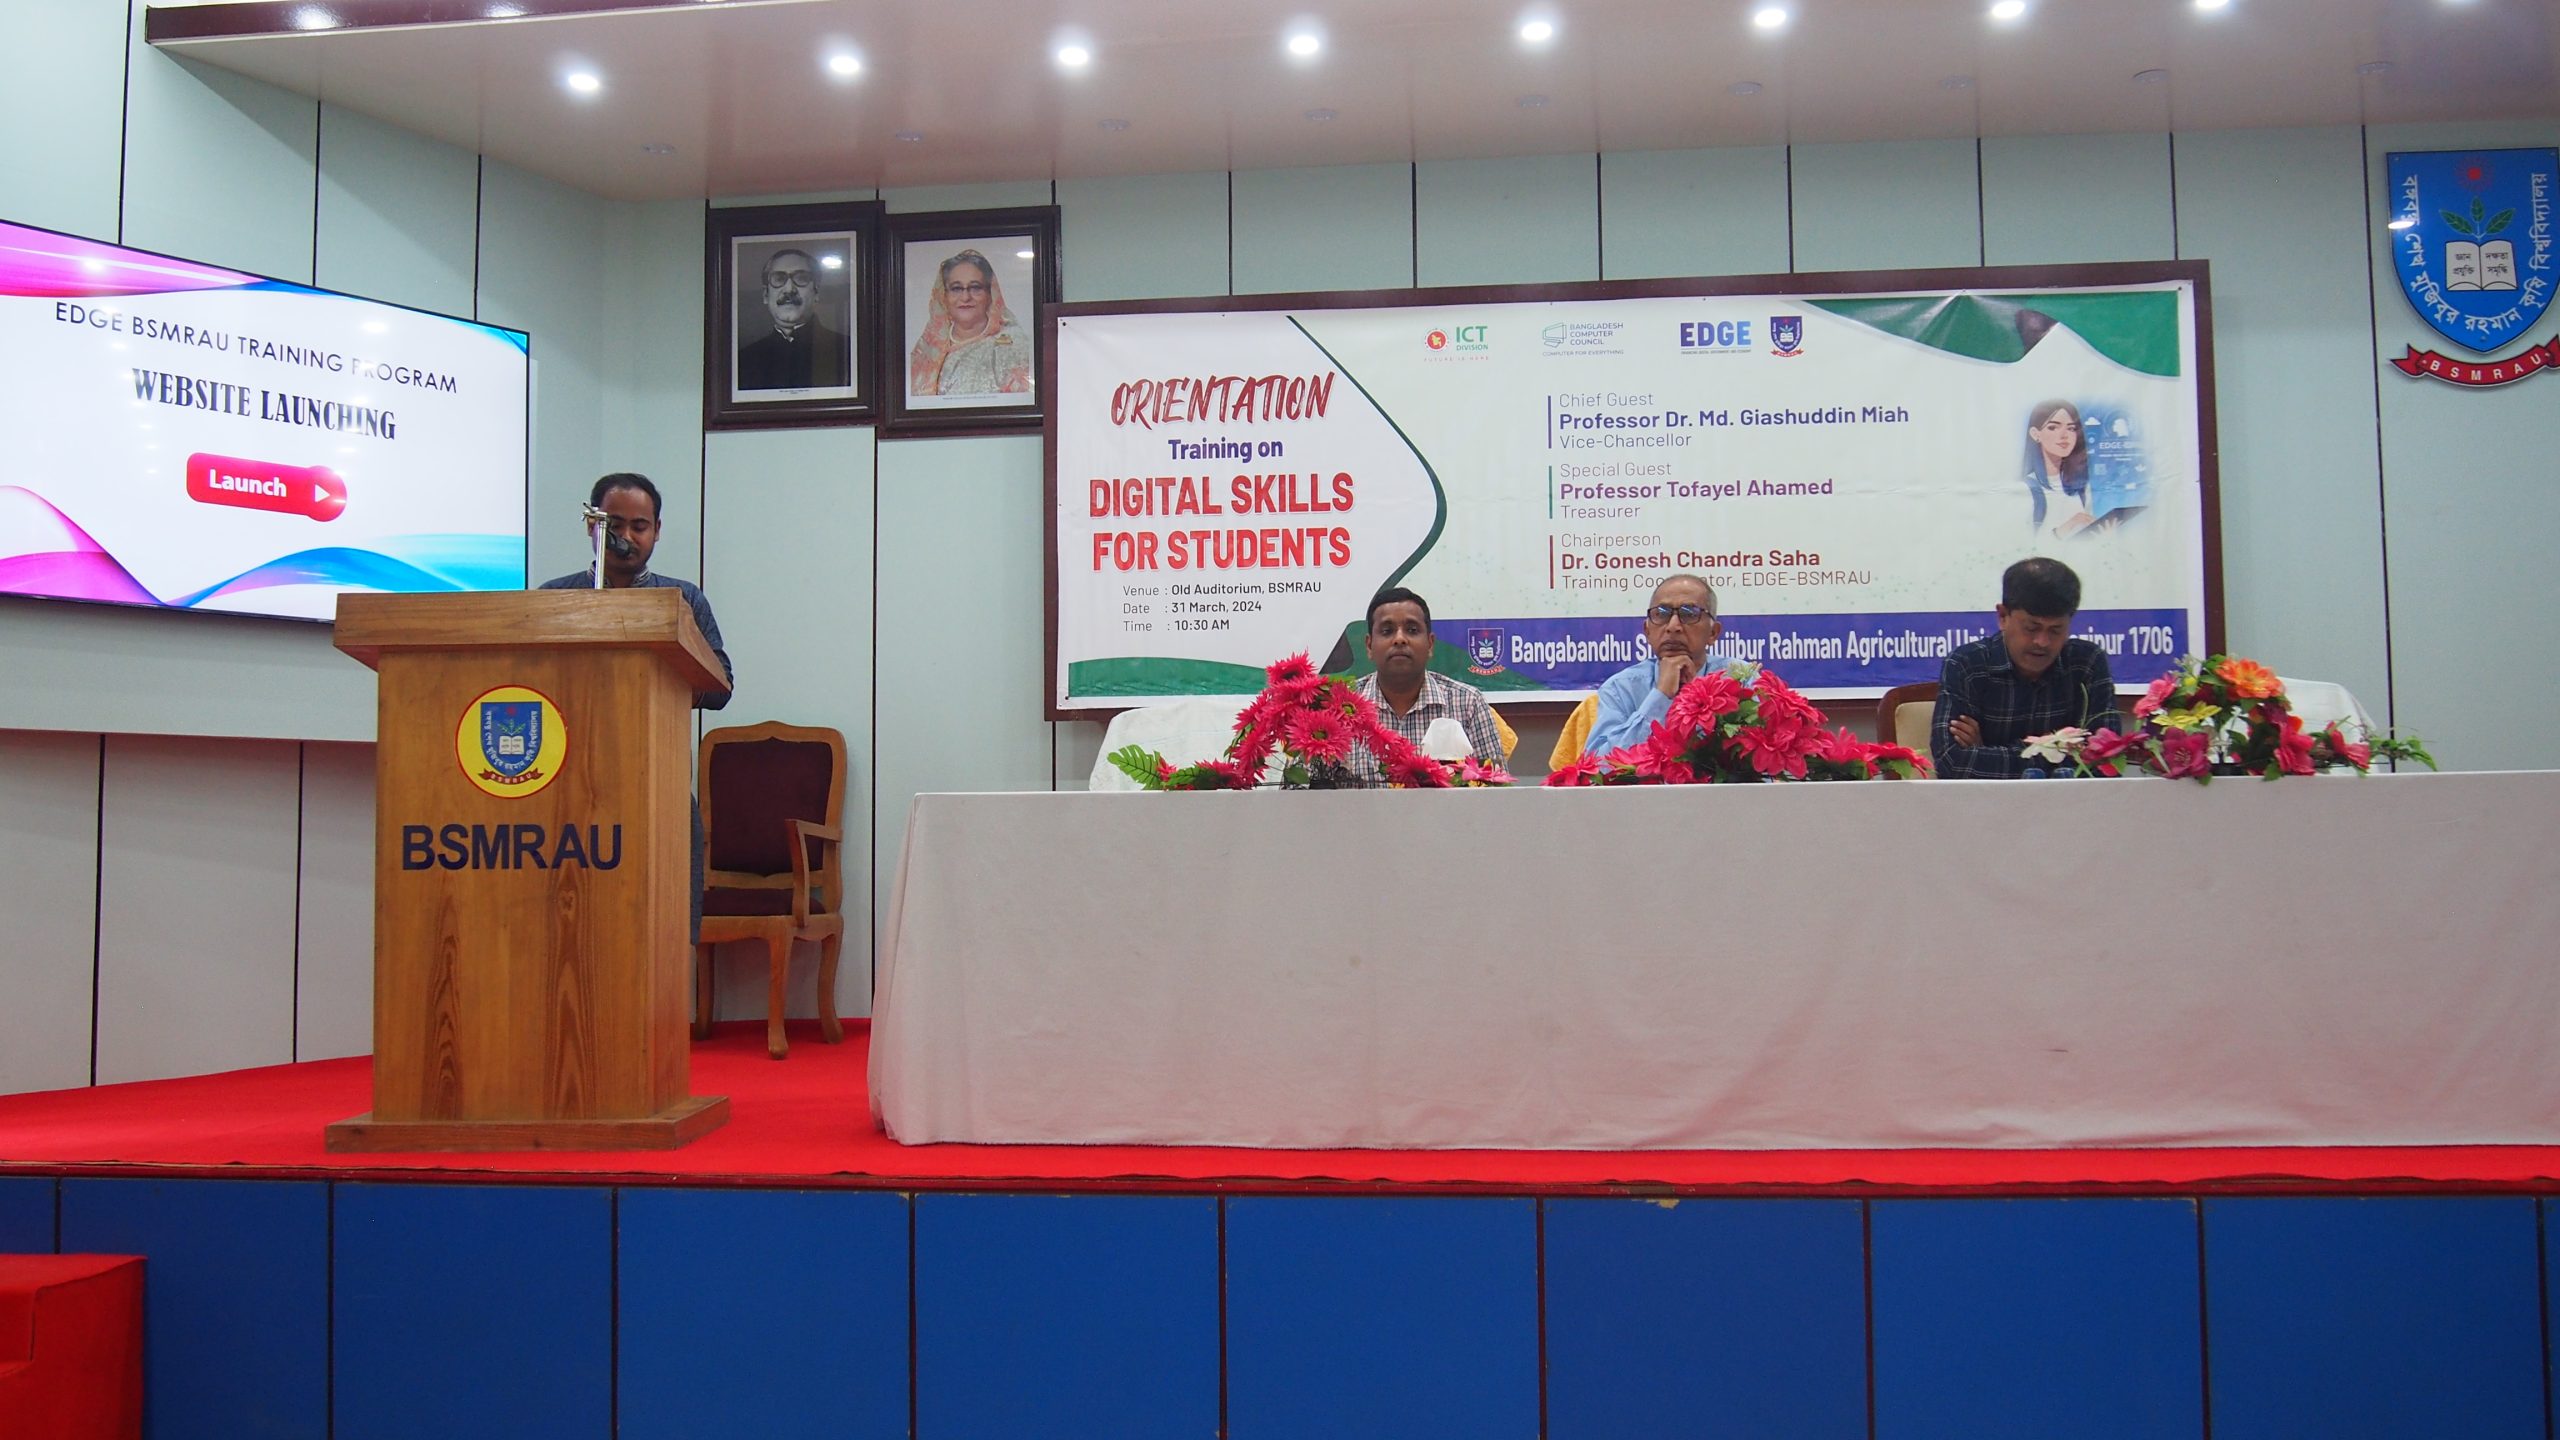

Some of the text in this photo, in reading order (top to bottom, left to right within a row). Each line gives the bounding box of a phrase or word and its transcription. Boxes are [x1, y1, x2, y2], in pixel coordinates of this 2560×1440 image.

[2405, 233, 2426, 267] শেখ
[2410, 271, 2460, 325] মুজিবুর
[2519, 275, 2548, 309] কৃষি
[1680, 321, 1751, 347] EDGE
[2465, 307, 2523, 335] রহমান
[55, 301, 457, 394] EDGE BSMRAU TRAINING PROGRAM
[1456, 326, 1488, 343] ICT
[1570, 338, 1604, 346] COUNCIL
[2429, 353, 2543, 381] BSMRAU
[132, 368, 397, 440] WEBSITE LAUNCHING
[1111, 371, 1335, 430] ORIENTATION
[1559, 392, 1654, 407] Chief Guest
[1559, 406, 1909, 430] Professor Dr. Md. Giashuddin Miah
[1168, 437, 1283, 463] Training on
[1560, 434, 1692, 449] Vice-Chancellor
[209, 468, 287, 498] Launch
[1560, 462, 1672, 481] Special Guest
[1089, 472, 1354, 518] DIGITAL SKILLS
[1560, 478, 1833, 501] Professor Tofayel Ahamed
[1561, 504, 1641, 519] Treasurer
[1093, 527, 1351, 571] FOR STUDENTS
[1561, 532, 1661, 550] Chairperson
[1562, 549, 1821, 570] Dr. Gonesh Chandra Saha
[1123, 585, 1160, 597] Venue
[1171, 583, 1191, 596] Old
[1194, 582, 1265, 596] Auditorium,
[1268, 581, 1322, 594] BSMRAU
[1562, 570, 1871, 592] Training Cootor, EDGE-BSMRAU
[1123, 603, 1150, 615] Date
[1172, 602, 1186, 613] 31
[1189, 601, 1229, 615] March,
[1232, 600, 1262, 612] 2024
[1123, 620, 1153, 632] Time
[1175, 619, 1209, 631] 10:30
[1211, 619, 1230, 630] AM
[1511, 633, 1632, 670] Bangabandhu
[1705, 631, 1766, 661] ujibur
[1769, 631, 1841, 660] Rahman
[1846, 629, 1952, 665] Agricultural
[2129, 626, 2174, 655] 1706
[402, 823, 622, 871] BSMRAU
